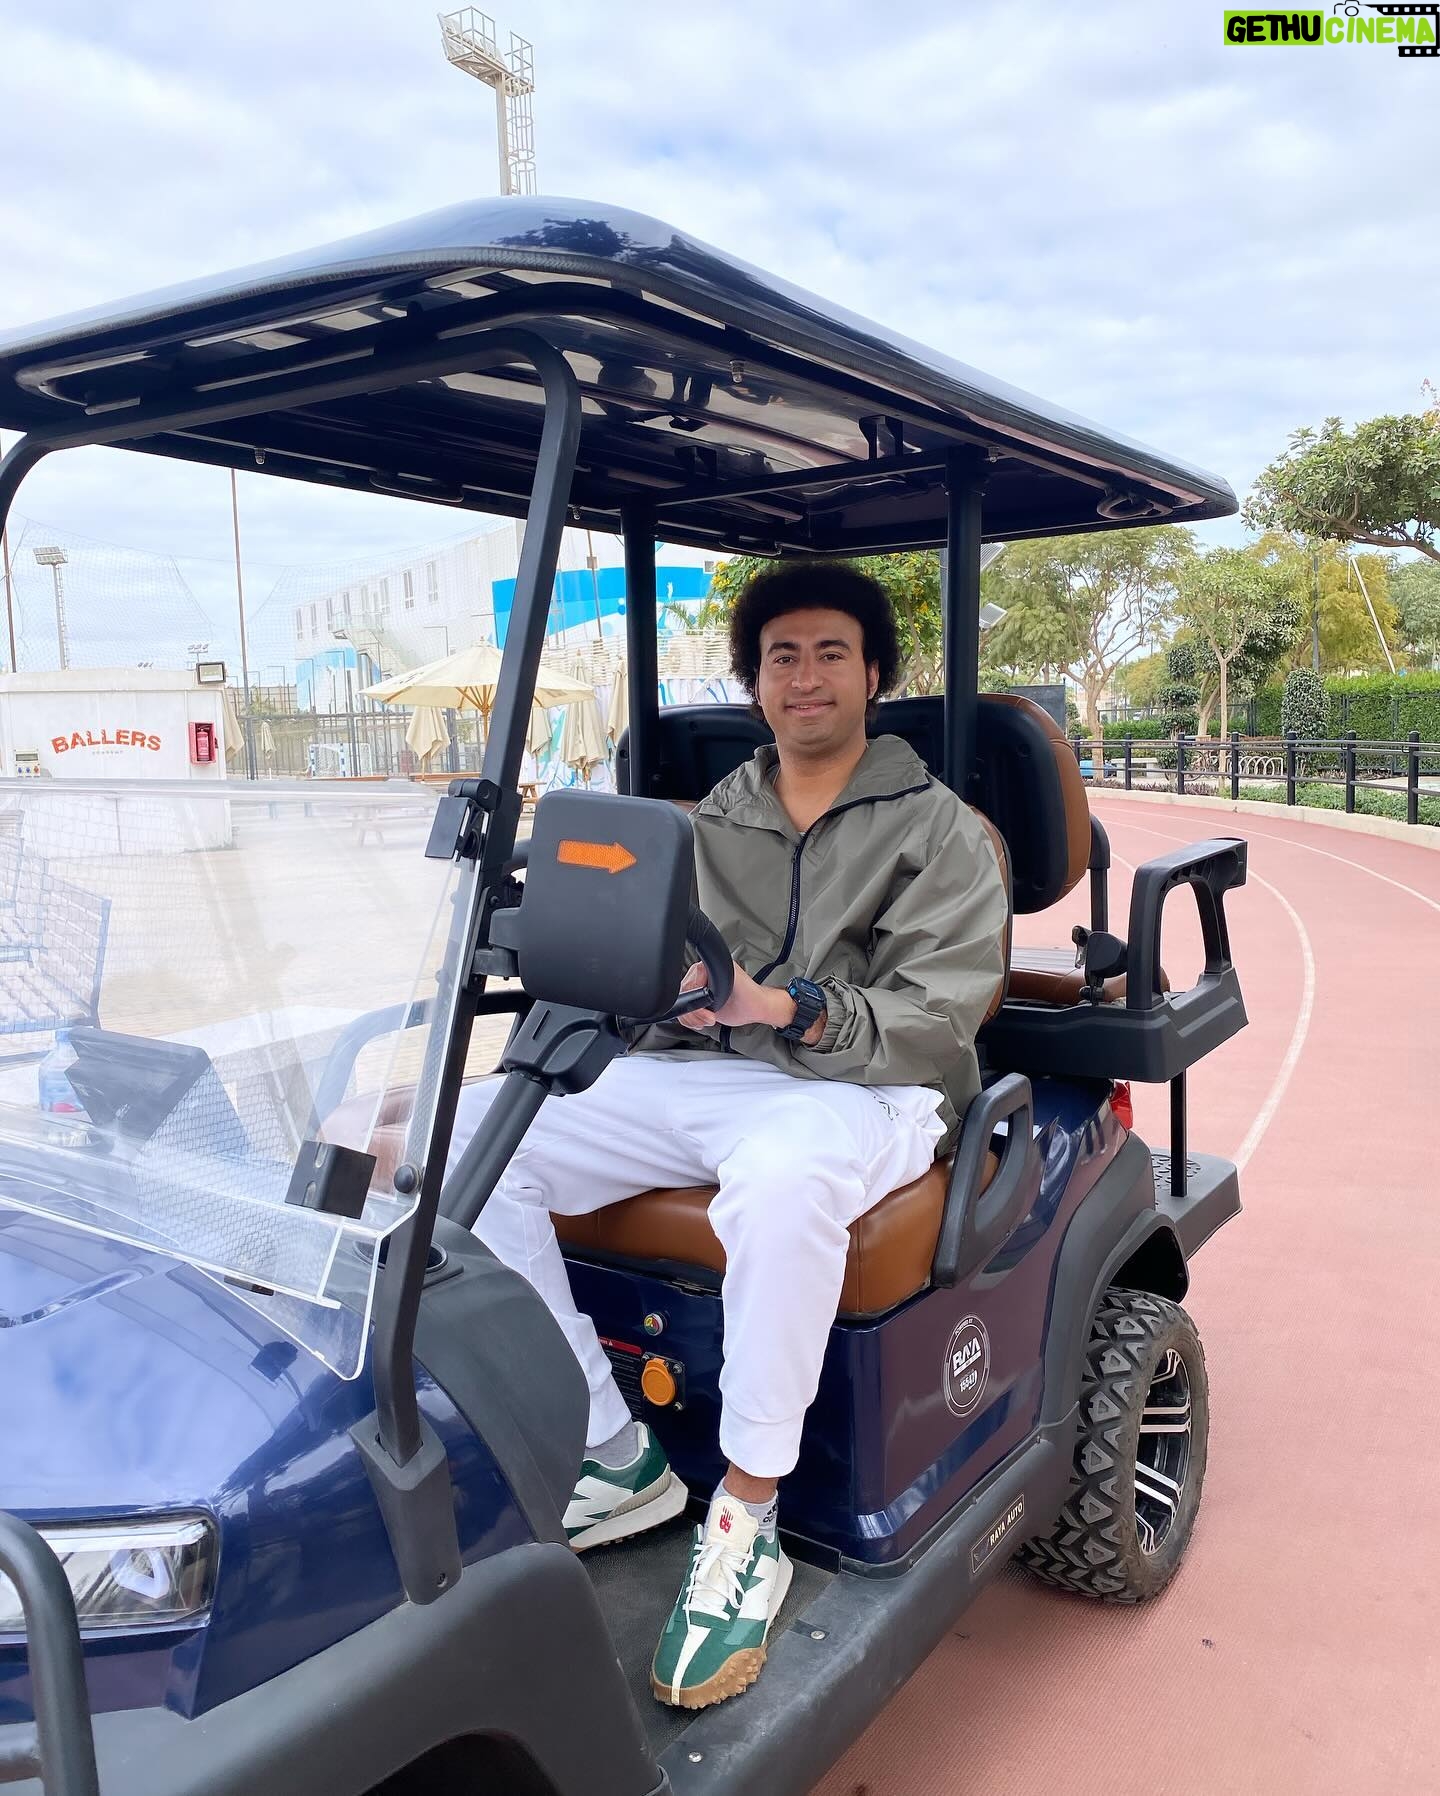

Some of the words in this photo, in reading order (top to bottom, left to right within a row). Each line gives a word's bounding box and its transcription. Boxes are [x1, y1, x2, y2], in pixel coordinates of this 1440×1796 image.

[51, 729, 161, 754] BALLERS
[990, 1521, 1006, 1546] RAYA
[1007, 1502, 1023, 1526] AUTO
